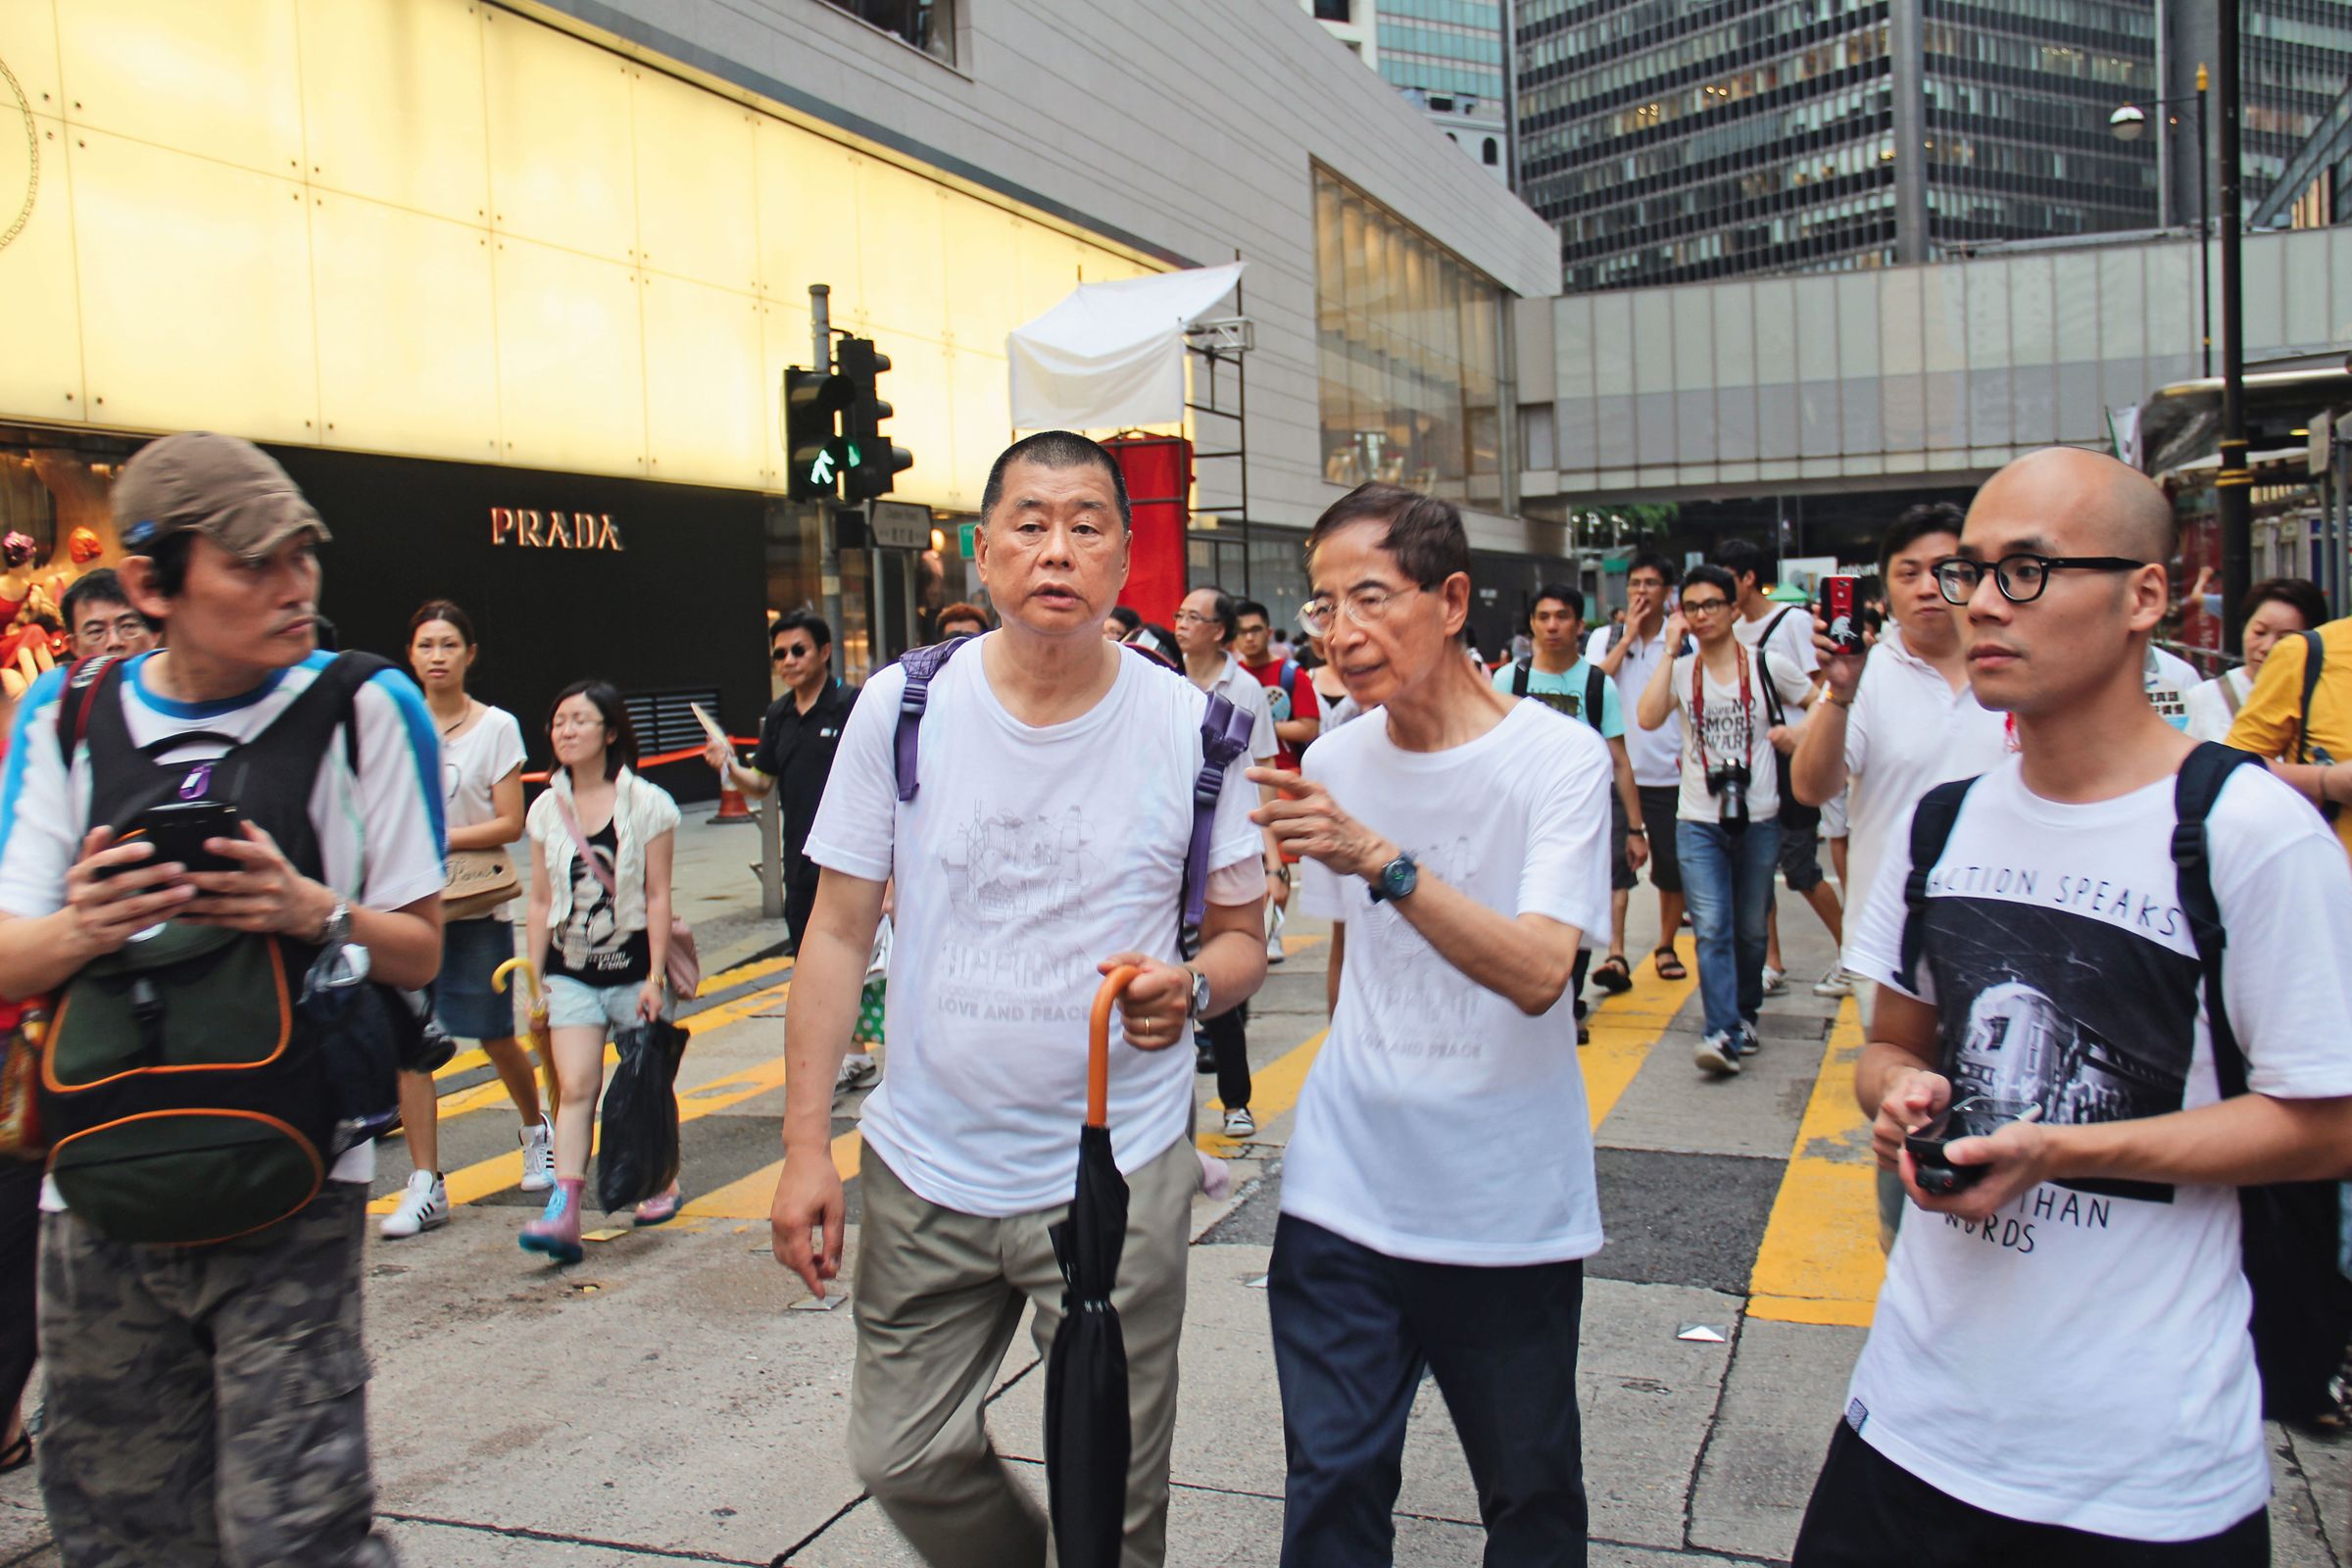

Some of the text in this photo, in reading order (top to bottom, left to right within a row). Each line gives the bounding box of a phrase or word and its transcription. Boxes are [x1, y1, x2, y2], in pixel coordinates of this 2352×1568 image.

[490, 507, 624, 551] PRADA
[1928, 866, 2182, 937] ACTION SPEAKS
[938, 996, 979, 1018] LOVE
[984, 1004, 1025, 1021] AND
